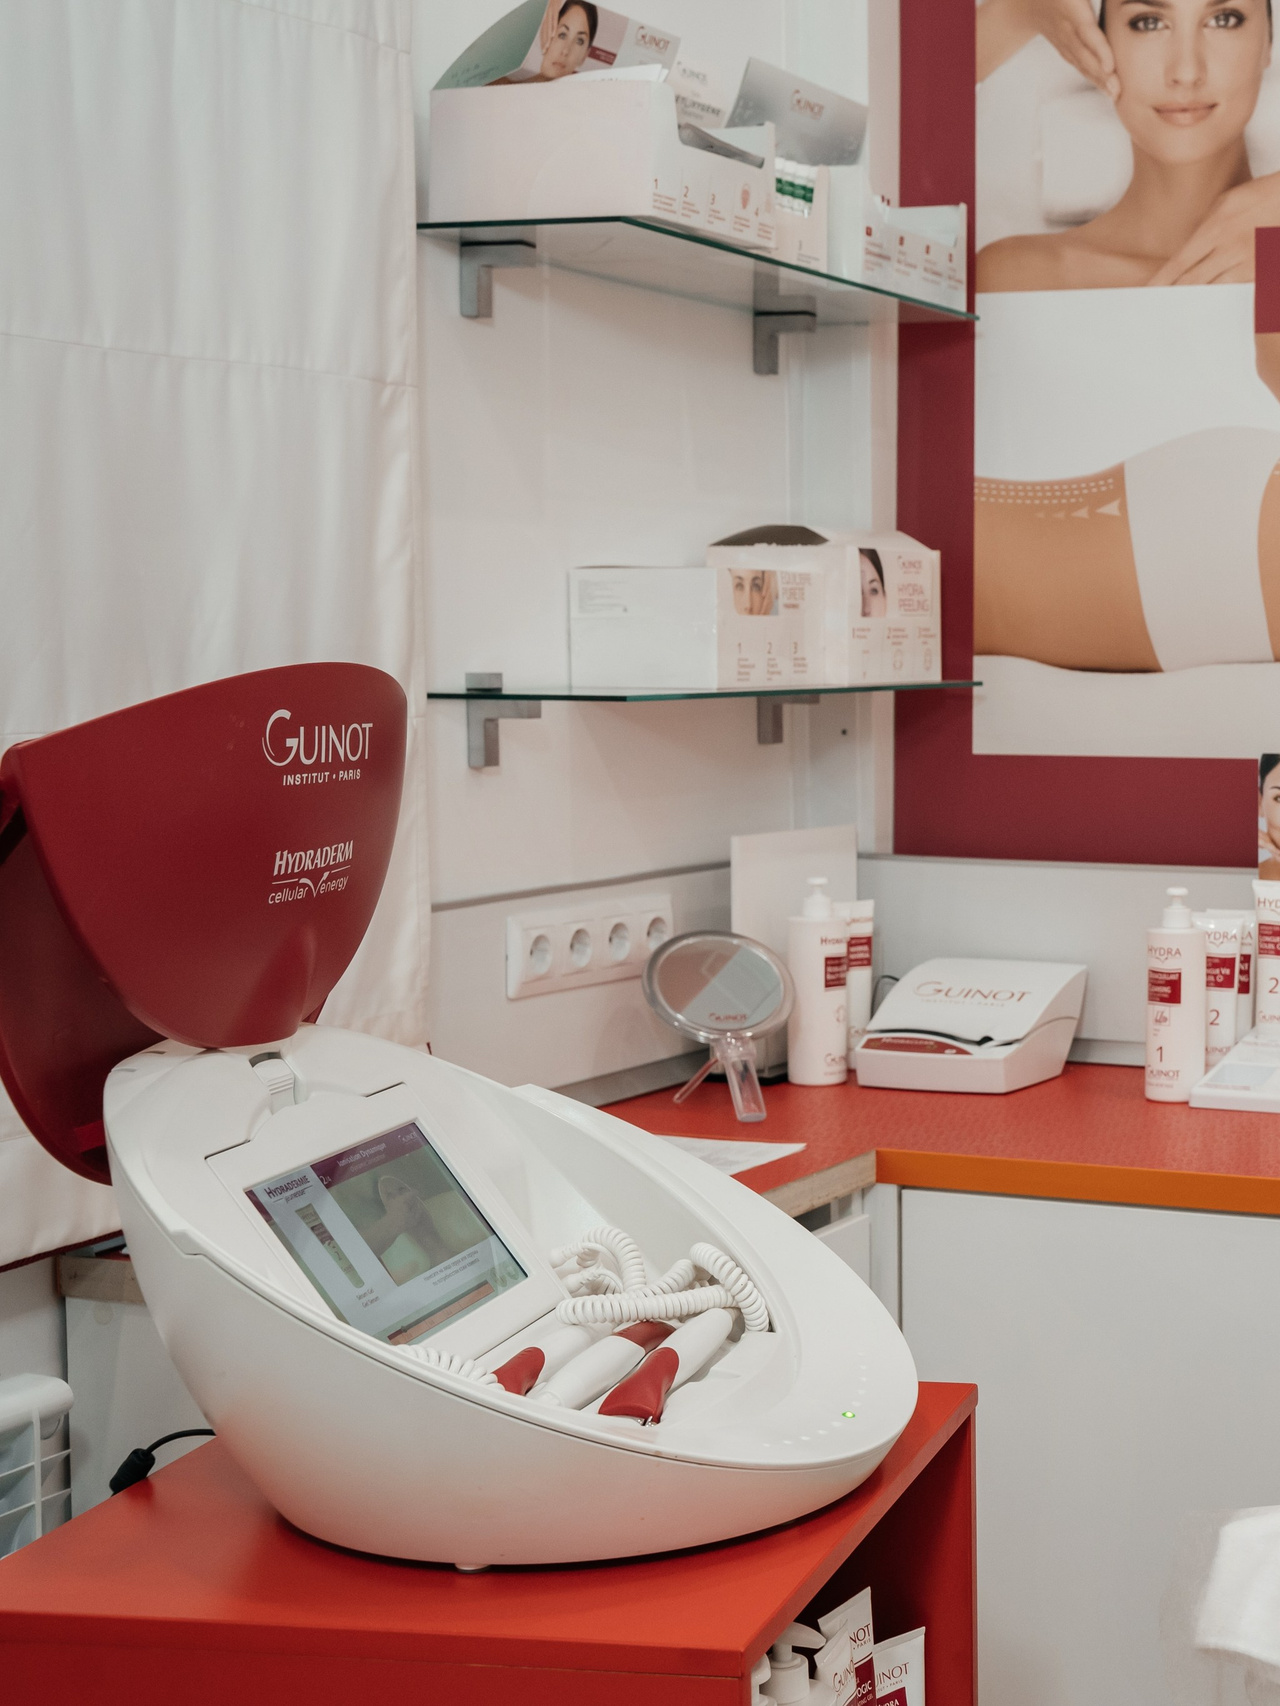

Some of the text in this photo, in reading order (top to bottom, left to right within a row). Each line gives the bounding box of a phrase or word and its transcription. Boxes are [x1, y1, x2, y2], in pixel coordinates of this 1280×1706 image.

[261, 708, 373, 767] GUINOT
[283, 768, 361, 786] INSTITUT PARIS
[273, 840, 354, 877] HYDRADERM
[268, 875, 349, 904] cellular energy
[1206, 931, 1238, 941] YDRA
[1147, 945, 1181, 957] HYDRA
[914, 981, 1031, 1002] GUINOT
[1268, 977, 1279, 994] 2
[1209, 1009, 1220, 1026] 2
[1156, 1046, 1163, 1063] 1
[264, 1175, 310, 1199] HYDRADERMIE
[849, 1623, 871, 1644] NOT
[833, 1657, 855, 1693] GUINO
[876, 1661, 909, 1687] INOT
[856, 1680, 872, 1698] OGIC
